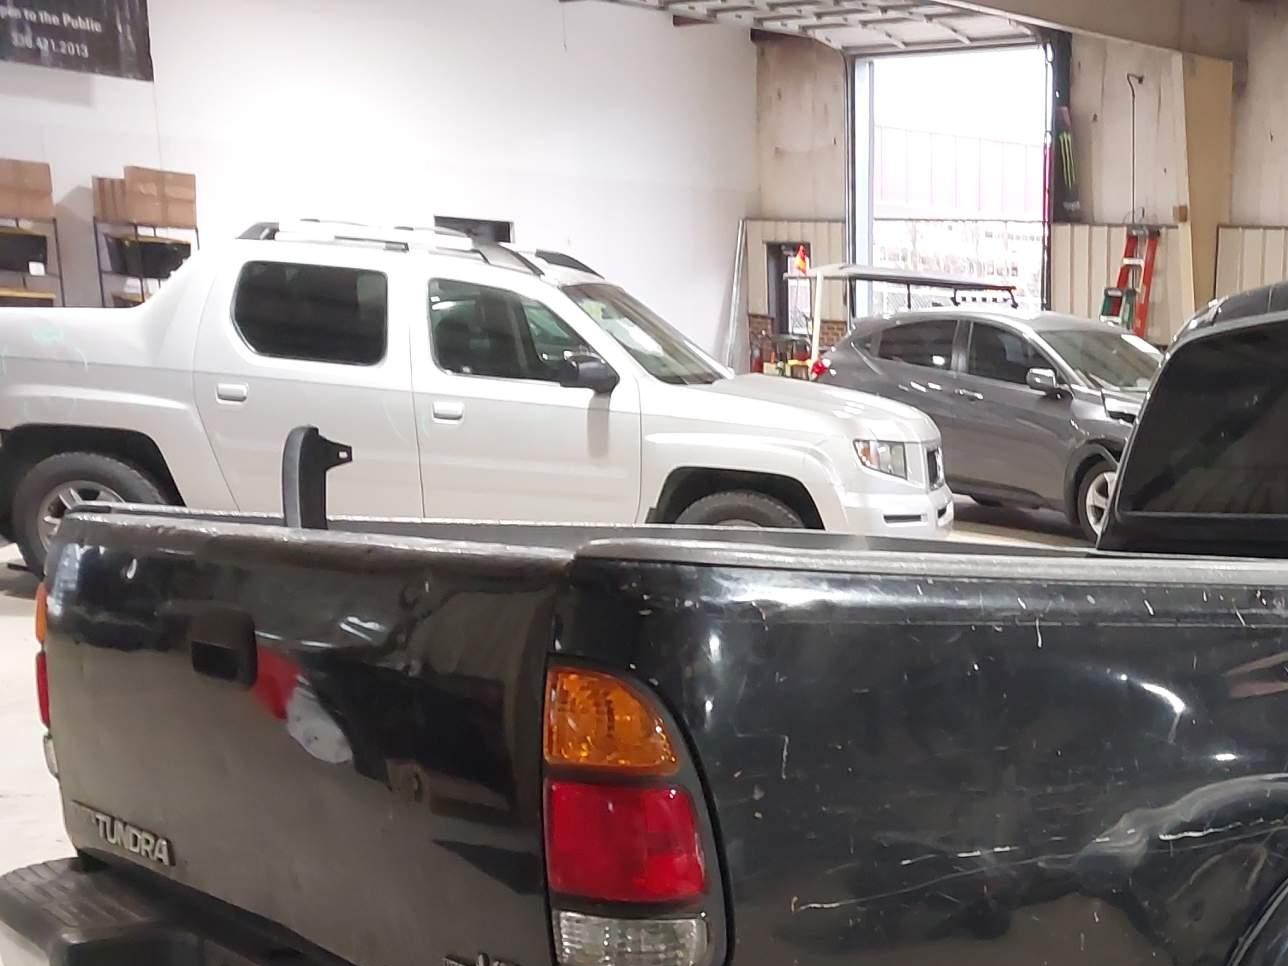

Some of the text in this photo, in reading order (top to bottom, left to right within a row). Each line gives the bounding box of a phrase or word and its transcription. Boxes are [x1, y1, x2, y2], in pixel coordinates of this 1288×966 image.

[23, 8, 37, 22] to
[38, 10, 60, 25] the
[62, 12, 102, 32] Public
[95, 813, 169, 866] TUNDRA
